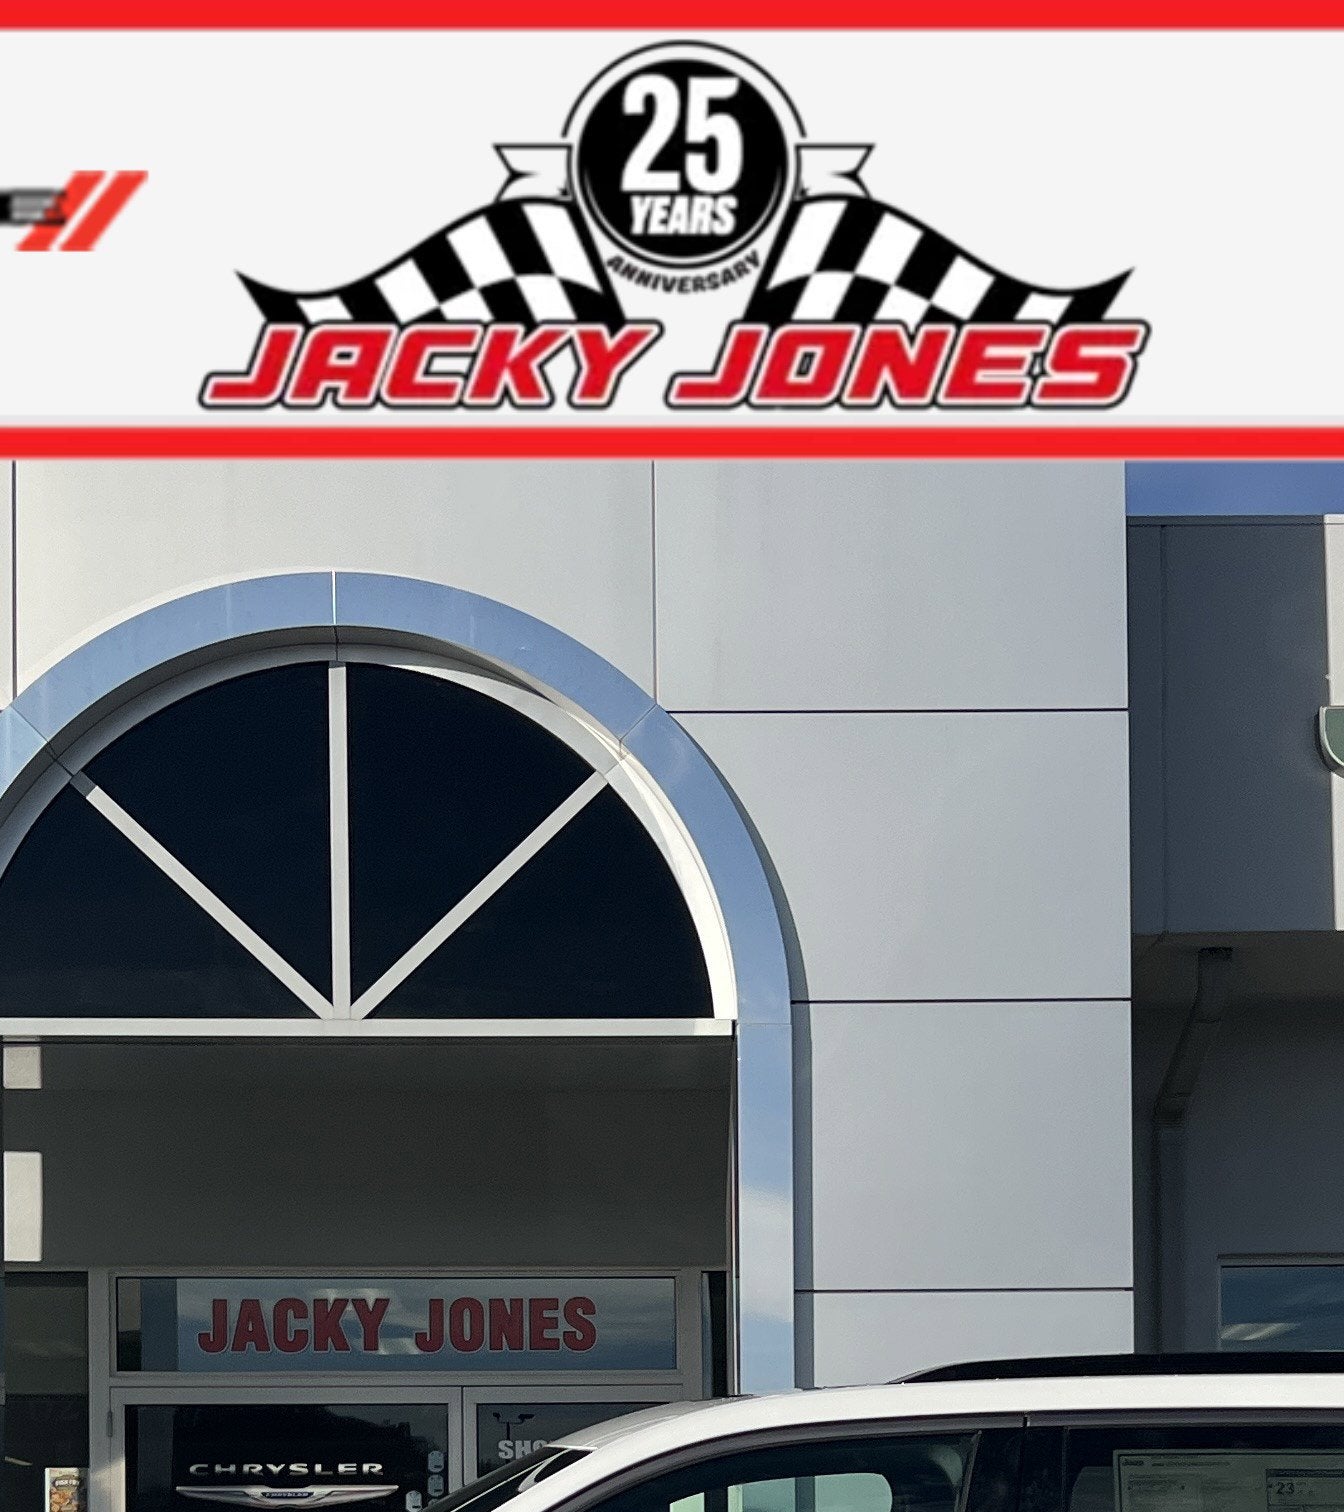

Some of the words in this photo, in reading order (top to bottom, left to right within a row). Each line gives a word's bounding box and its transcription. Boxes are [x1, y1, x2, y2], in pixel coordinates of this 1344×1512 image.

[197, 1297, 390, 1353] JACKY
[415, 1296, 597, 1353] JONES
[189, 1463, 384, 1476] CHRYSLER
